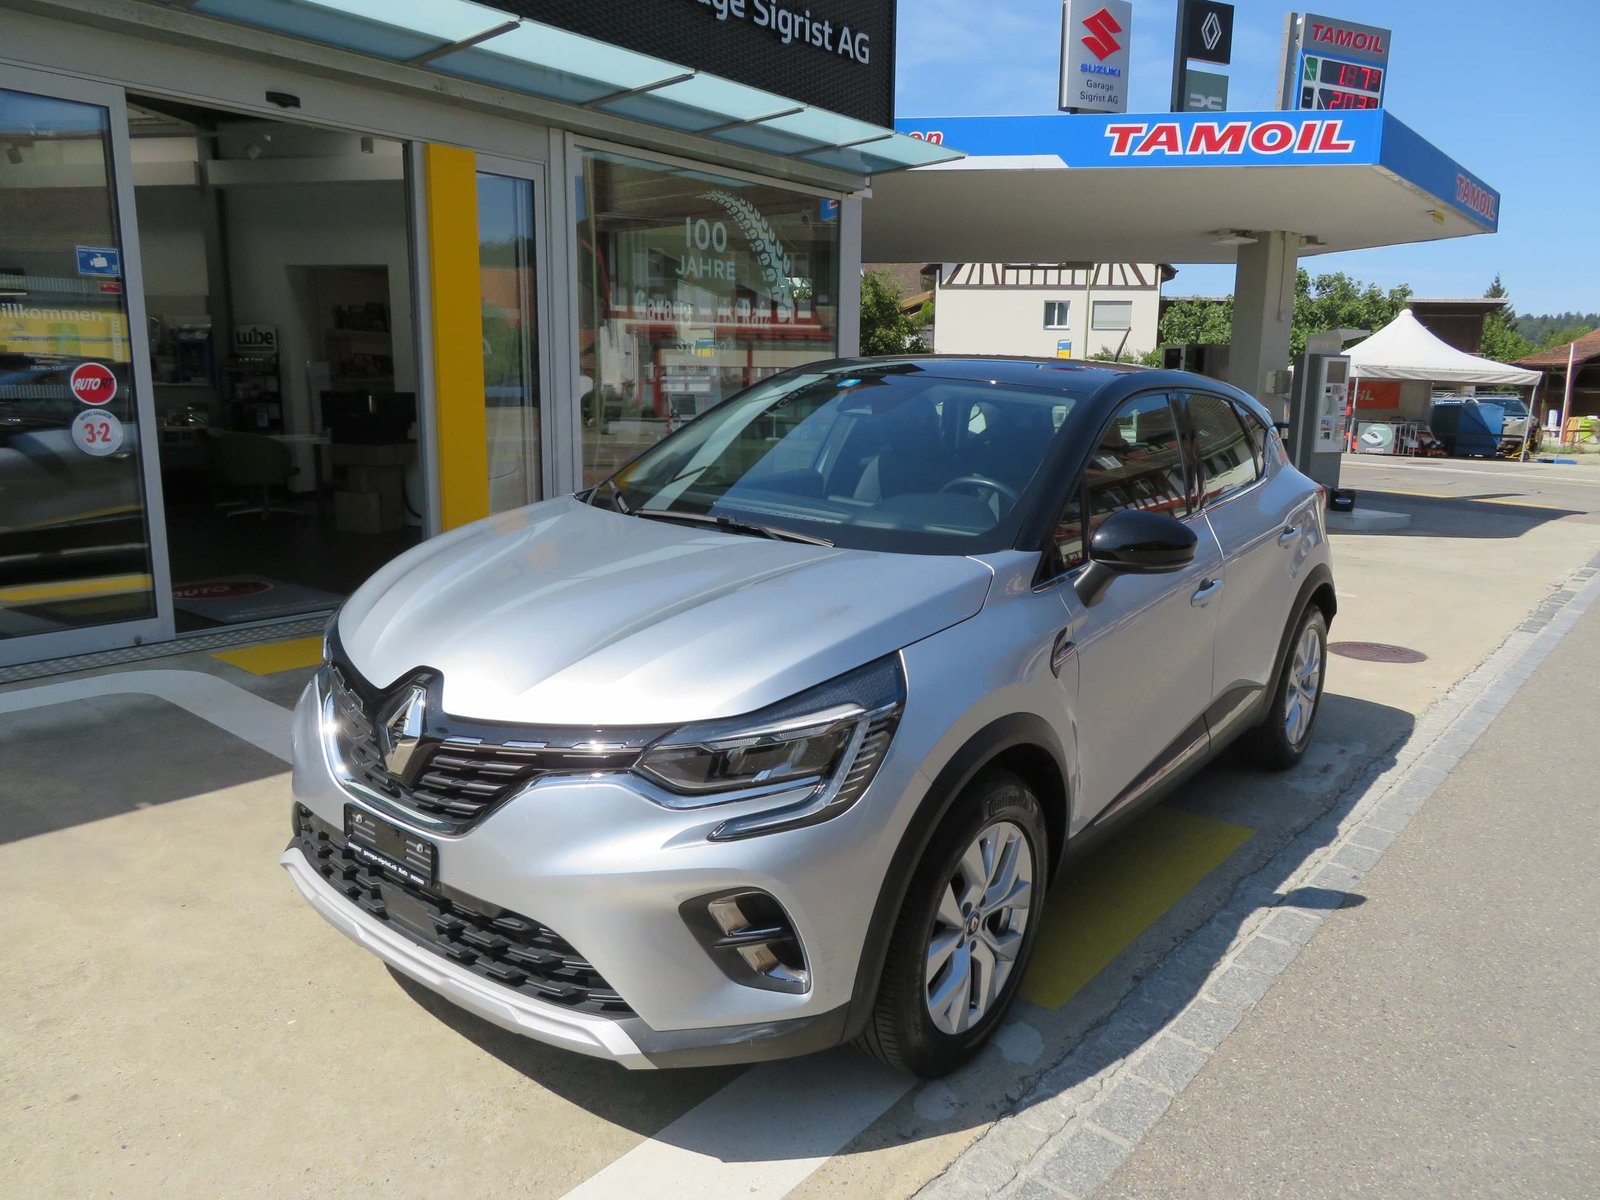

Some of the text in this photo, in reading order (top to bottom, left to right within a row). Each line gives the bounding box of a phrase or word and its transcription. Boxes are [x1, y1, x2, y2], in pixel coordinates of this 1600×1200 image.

[753, 0, 832, 51] Sigrist
[838, 26, 870, 64] AG
[1312, 23, 1384, 55] TAMOIL
[1080, 63, 1121, 78] SUZUKI
[1086, 79, 1115, 93] Garage
[1079, 91, 1119, 105] Sigrist AG
[1105, 120, 1355, 156] TAMOIL
[1456, 173, 1495, 222] TAMOIL
[685, 216, 728, 253] 100
[675, 255, 737, 281] JAHRE
